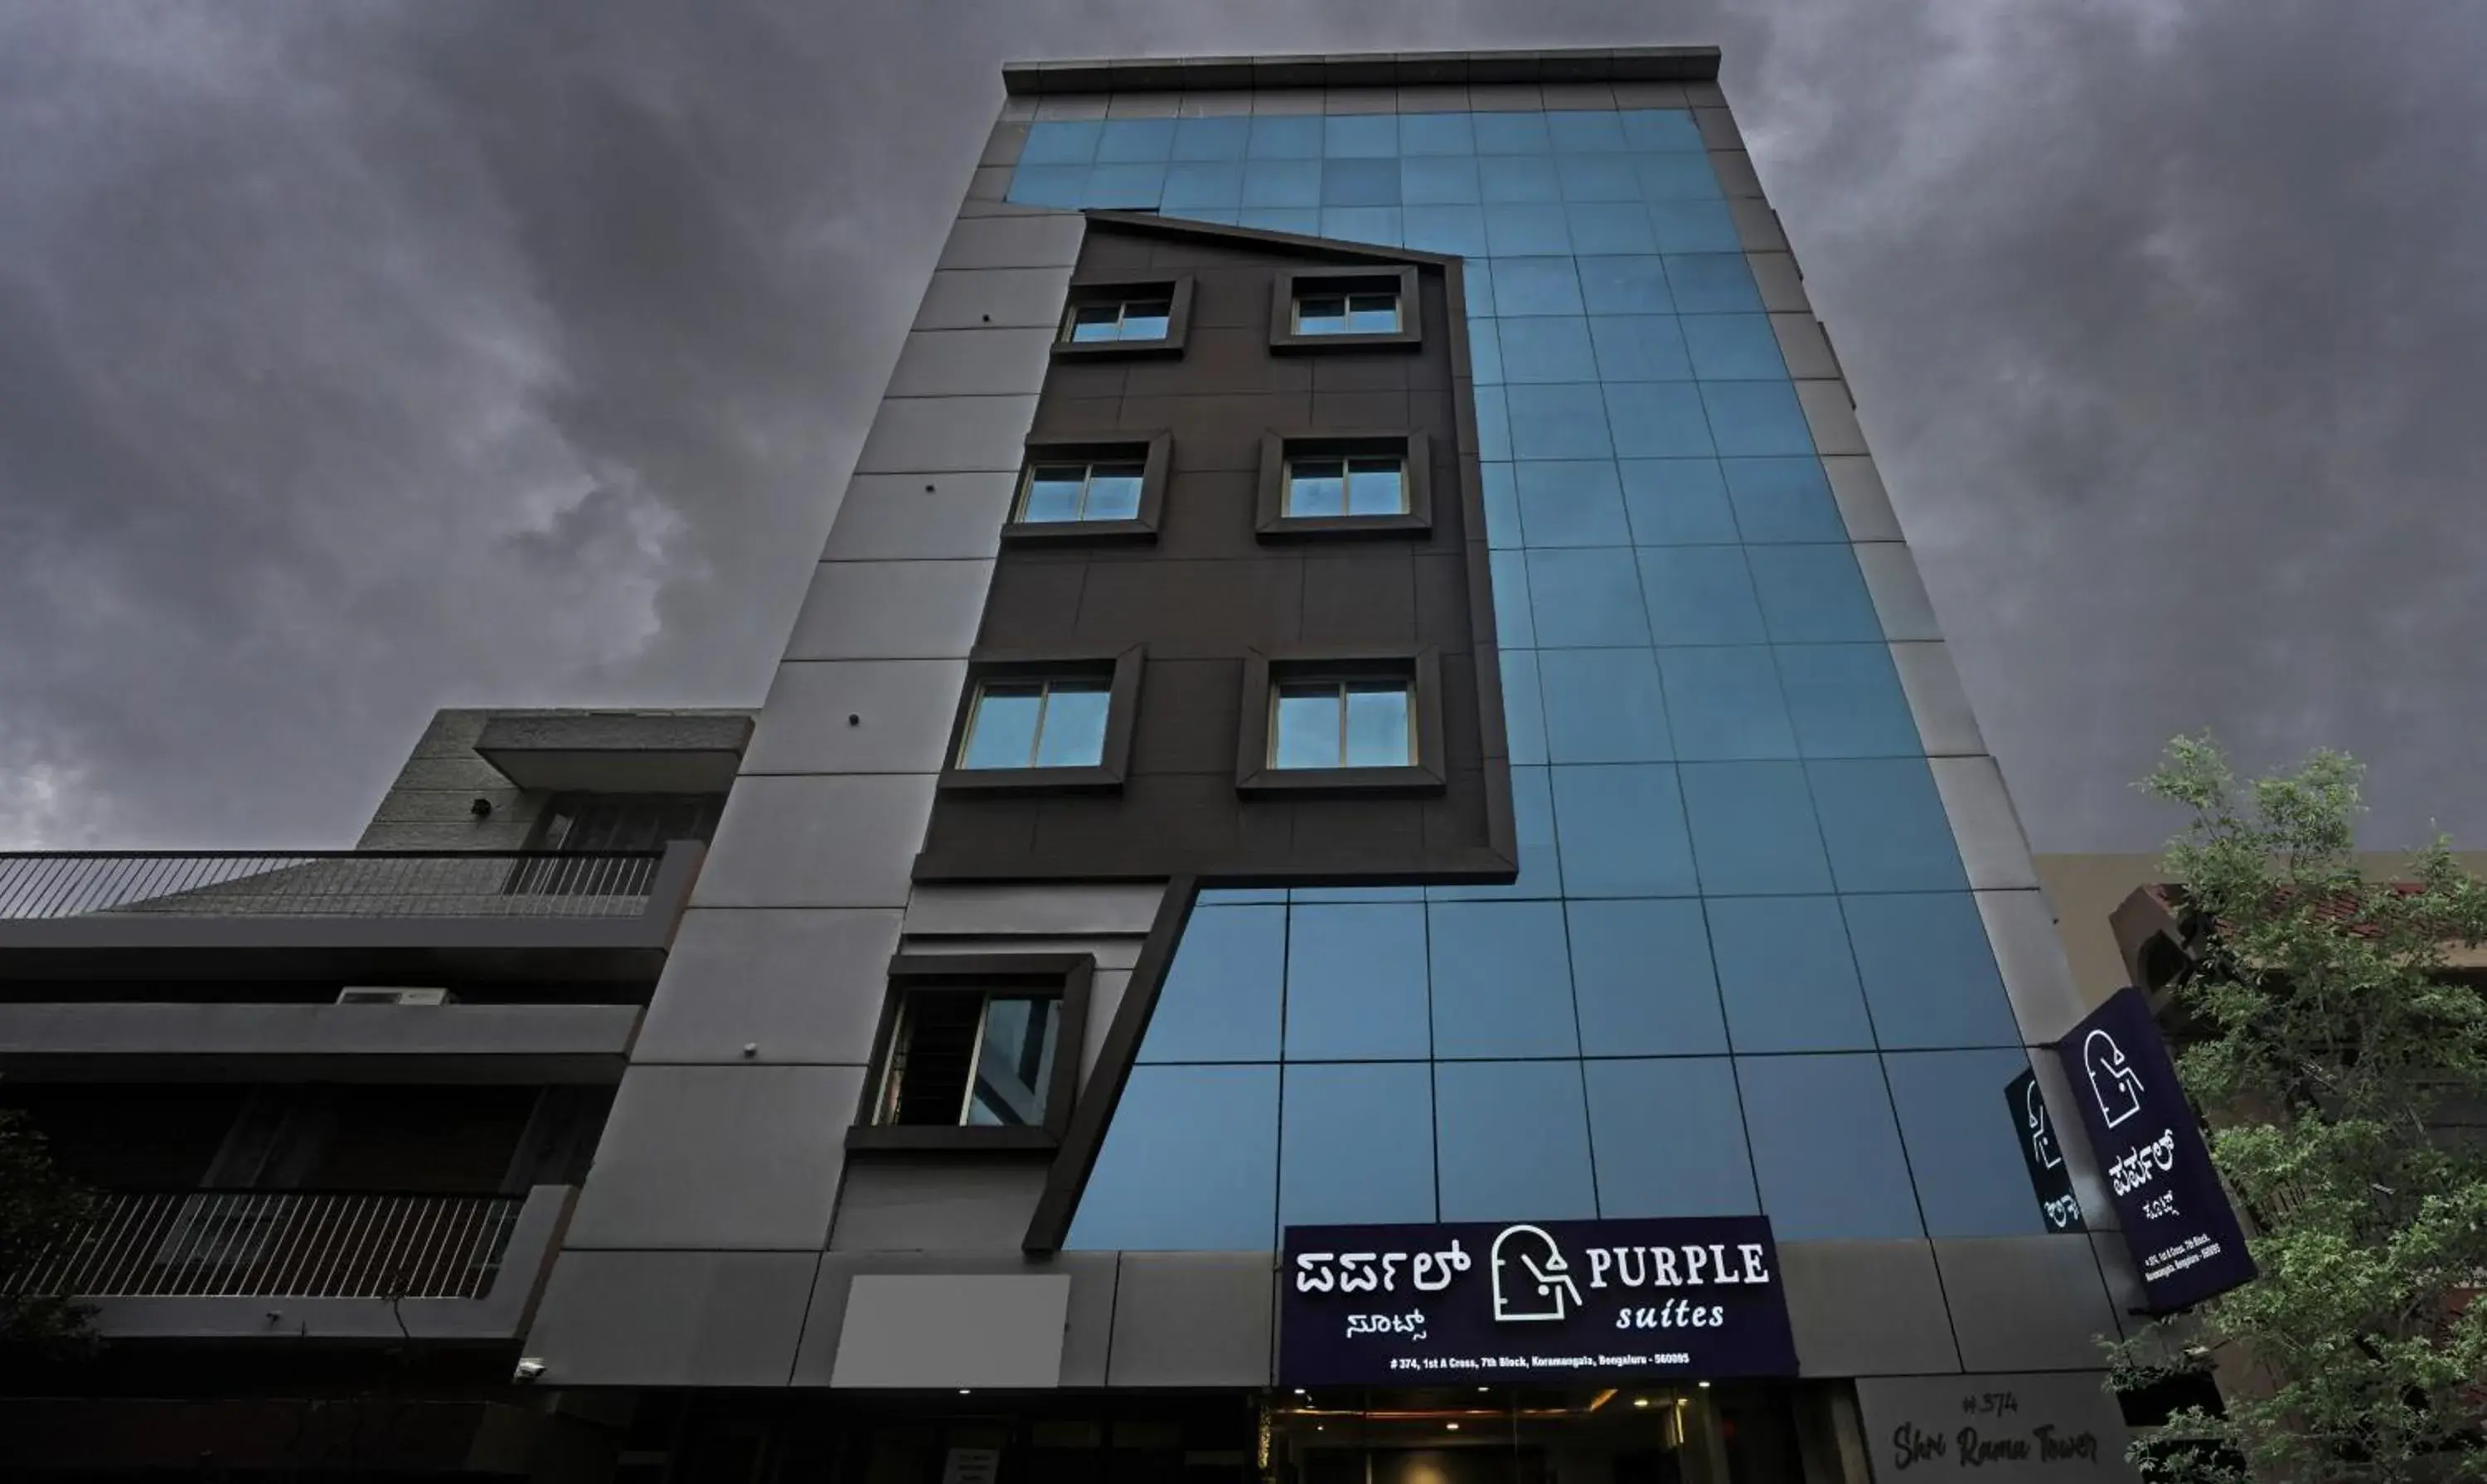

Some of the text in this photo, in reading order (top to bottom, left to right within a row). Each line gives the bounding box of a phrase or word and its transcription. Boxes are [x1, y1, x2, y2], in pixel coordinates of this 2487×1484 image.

[1296, 1239, 1472, 1292] ಪರ್ಪಲ್
[1585, 1244, 1770, 1288] PURPLE
[1616, 1297, 1724, 1329] suites
[1423, 1358, 1439, 1369] 1st
[1440, 1358, 1448, 1369] A
[1449, 1357, 1480, 1370] Cross,
[1481, 1357, 1497, 1367] 7th
[1498, 1356, 1530, 1369] Block,
[1597, 1355, 1647, 1367] Bengaluru
[1893, 1420, 2097, 1471] Shri Rama Tower
